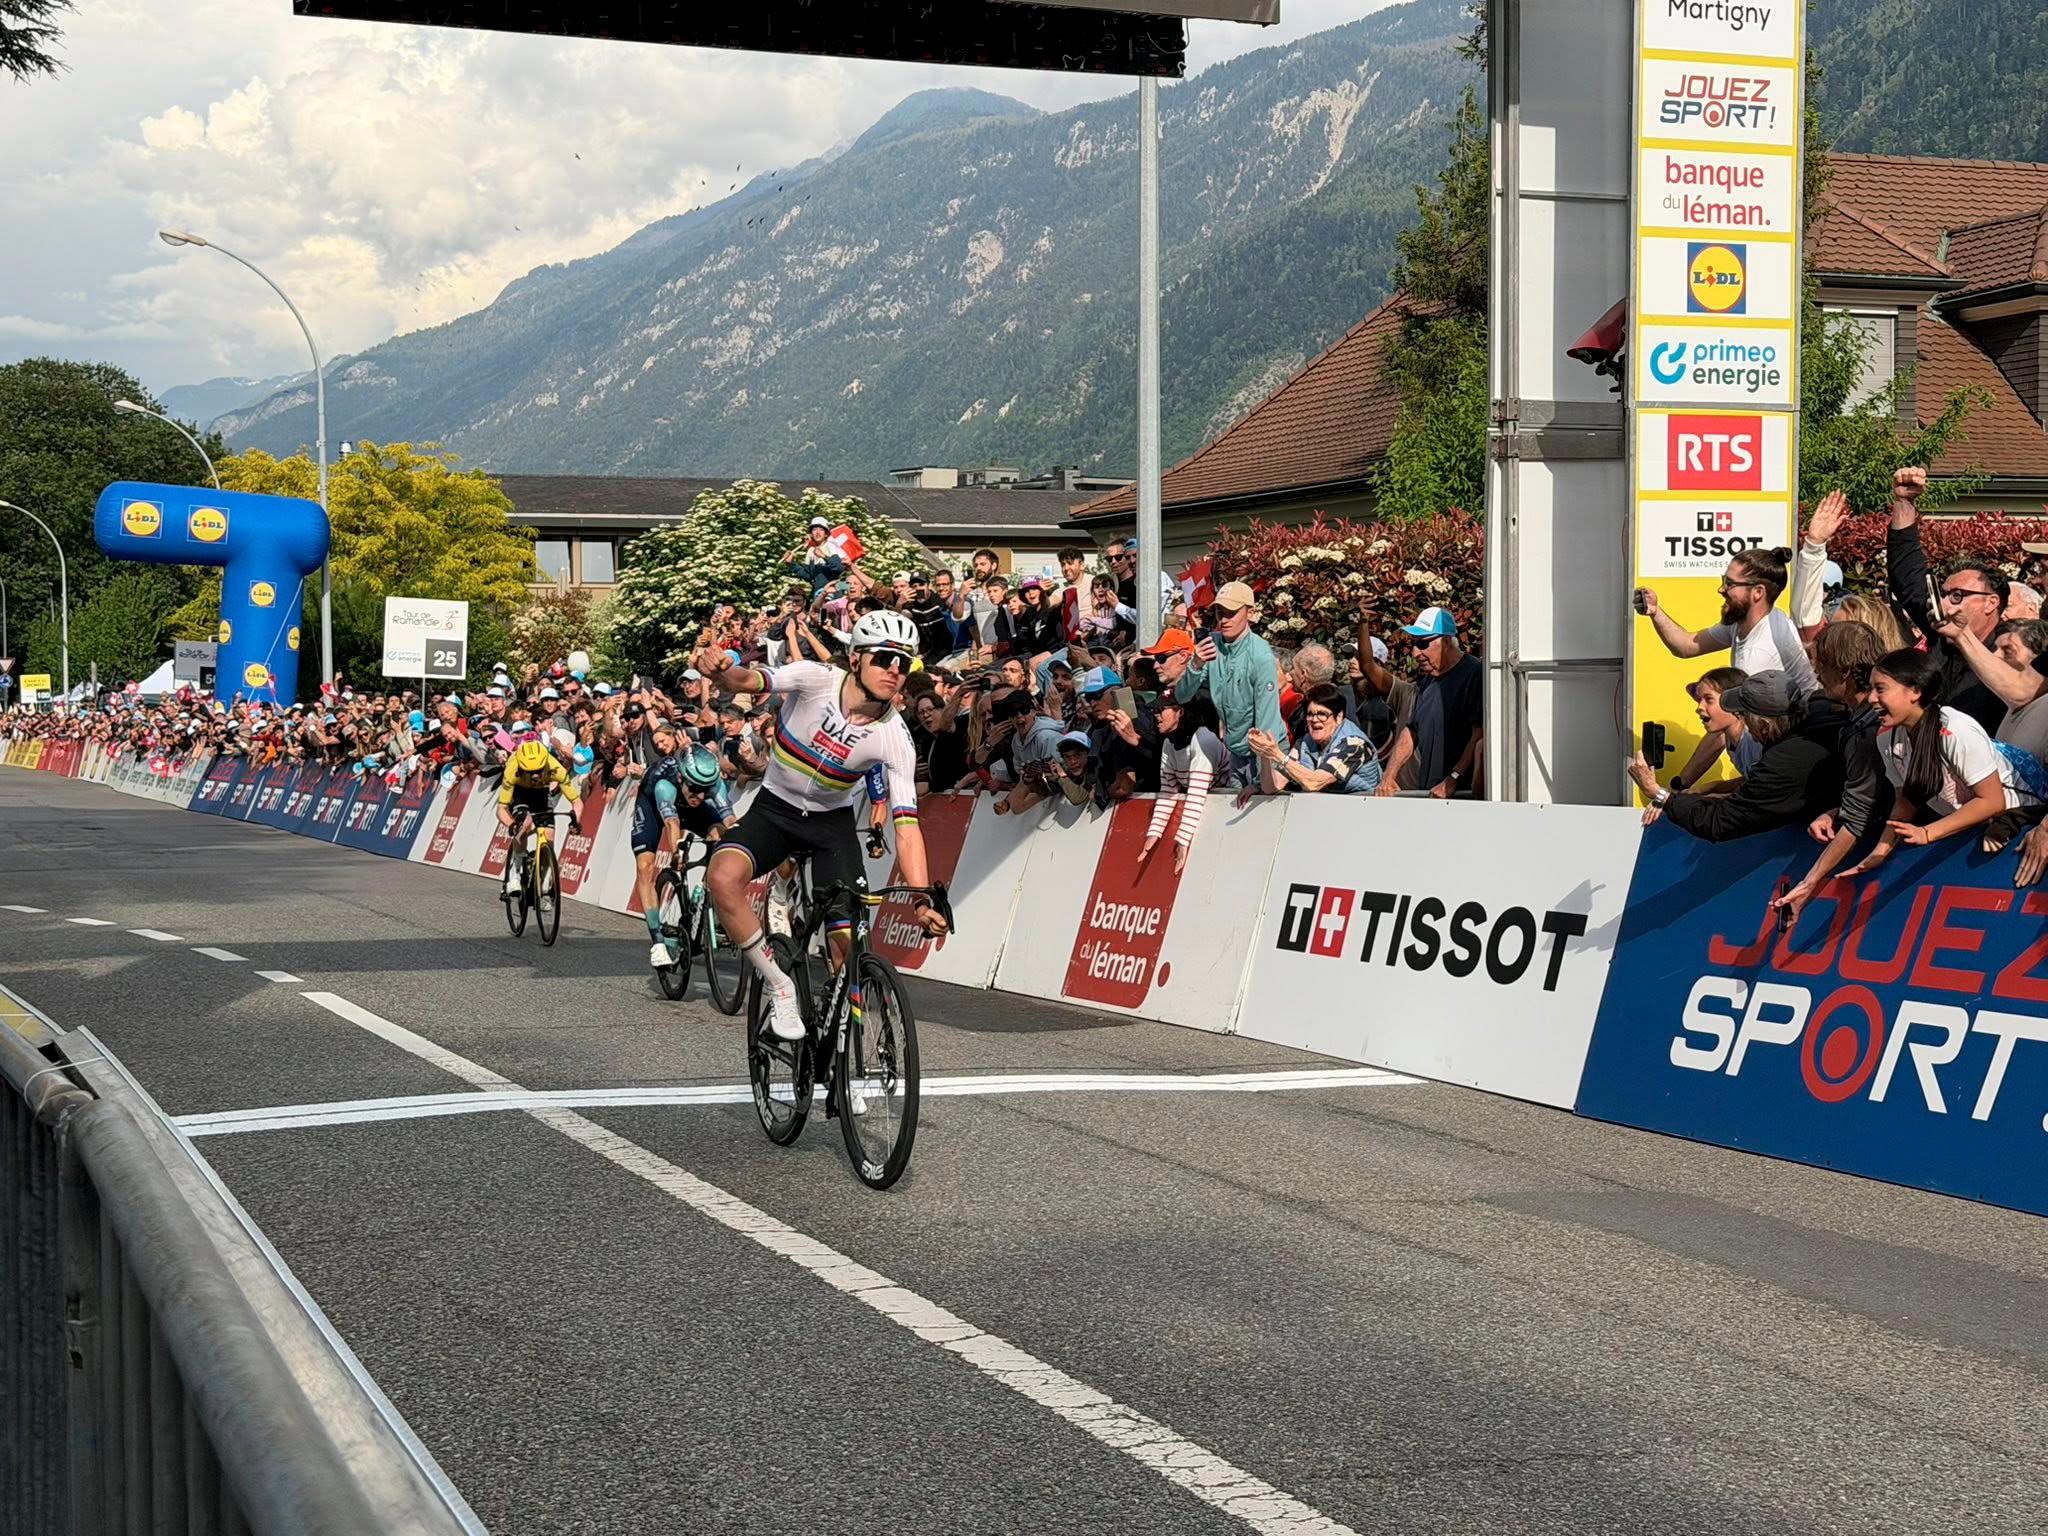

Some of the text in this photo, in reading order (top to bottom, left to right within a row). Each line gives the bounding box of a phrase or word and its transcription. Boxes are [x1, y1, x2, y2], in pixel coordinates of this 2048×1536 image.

[1668, 0, 1771, 31] Martigny
[1664, 74, 1771, 103] JOUEZ
[1666, 155, 1764, 194] banque
[1663, 194, 1771, 226] du léman.
[1693, 339, 1776, 365] primeo
[1692, 364, 1780, 393] energie
[1677, 433, 1753, 473] RTS
[1664, 537, 1763, 556] TISSOT
[1664, 561, 1687, 569] SWISS
[1689, 561, 1723, 569] WATCHES
[433, 650, 457, 668] 25
[821, 716, 861, 749] UAE
[1090, 892, 1161, 944] banque
[1080, 938, 1093, 960] du
[1360, 891, 1588, 992] TISSOT
